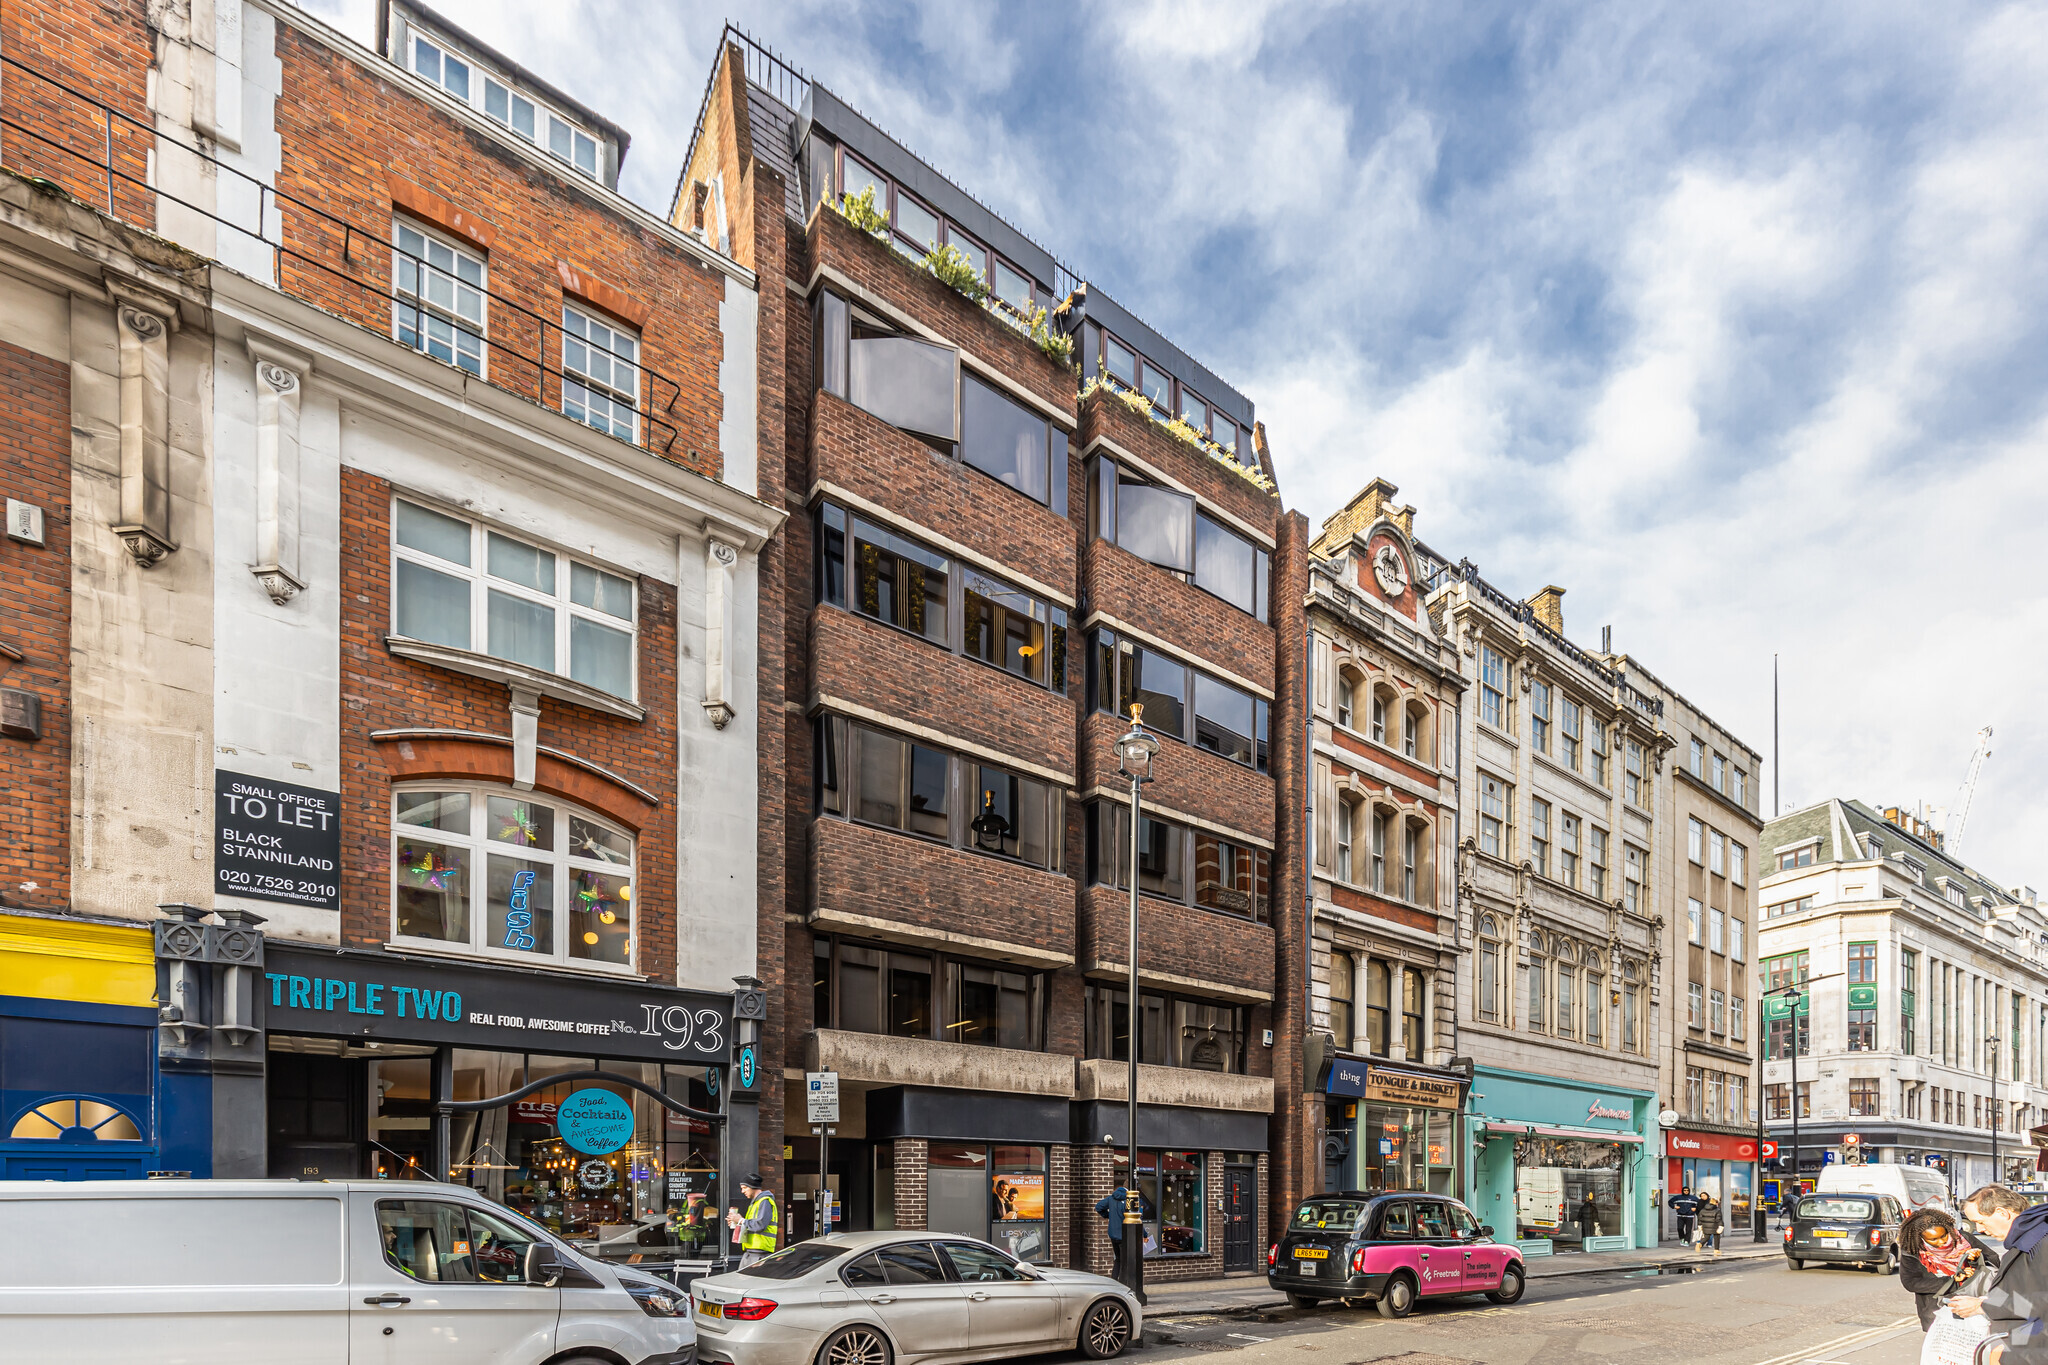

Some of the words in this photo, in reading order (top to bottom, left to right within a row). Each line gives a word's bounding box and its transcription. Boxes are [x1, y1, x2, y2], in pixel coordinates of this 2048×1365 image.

[232, 783, 276, 800] SMALL
[278, 792, 325, 809] OFFICE
[223, 793, 267, 818] TO
[278, 803, 333, 830] LET
[223, 828, 282, 848] BLACK
[222, 844, 333, 871] STANNILAND
[220, 870, 250, 884] 020
[255, 874, 294, 890] 7526
[298, 882, 336, 897] 2010
[228, 883, 327, 903] www.blackstanniland.com
[265, 972, 385, 1016] TRIPLE
[392, 986, 462, 1022] TWO
[470, 1012, 496, 1026] REAL
[498, 1015, 526, 1030] FOOD,
[528, 1018, 574, 1032] AWESOME
[576, 1022, 610, 1036] COFFEE
[610, 1020, 637, 1034] No.
[640, 1004, 723, 1052] 193
[1370, 1074, 1409, 1090] TONGUE
[1410, 1080, 1418, 1090] &
[1420, 1081, 1455, 1095] BRISKET
[580, 1097, 607, 1108] Food,
[562, 1108, 626, 1120] Cocktails
[571, 1119, 580, 1128] &
[571, 1124, 626, 1140] AWESOME
[1385, 1124, 1399, 1132] HOT
[585, 1137, 619, 1149] Coffee
[1679, 1139, 1700, 1149] vodafone
[303, 1167, 319, 1175] 193
[1433, 1269, 1460, 1278] Freetrade
